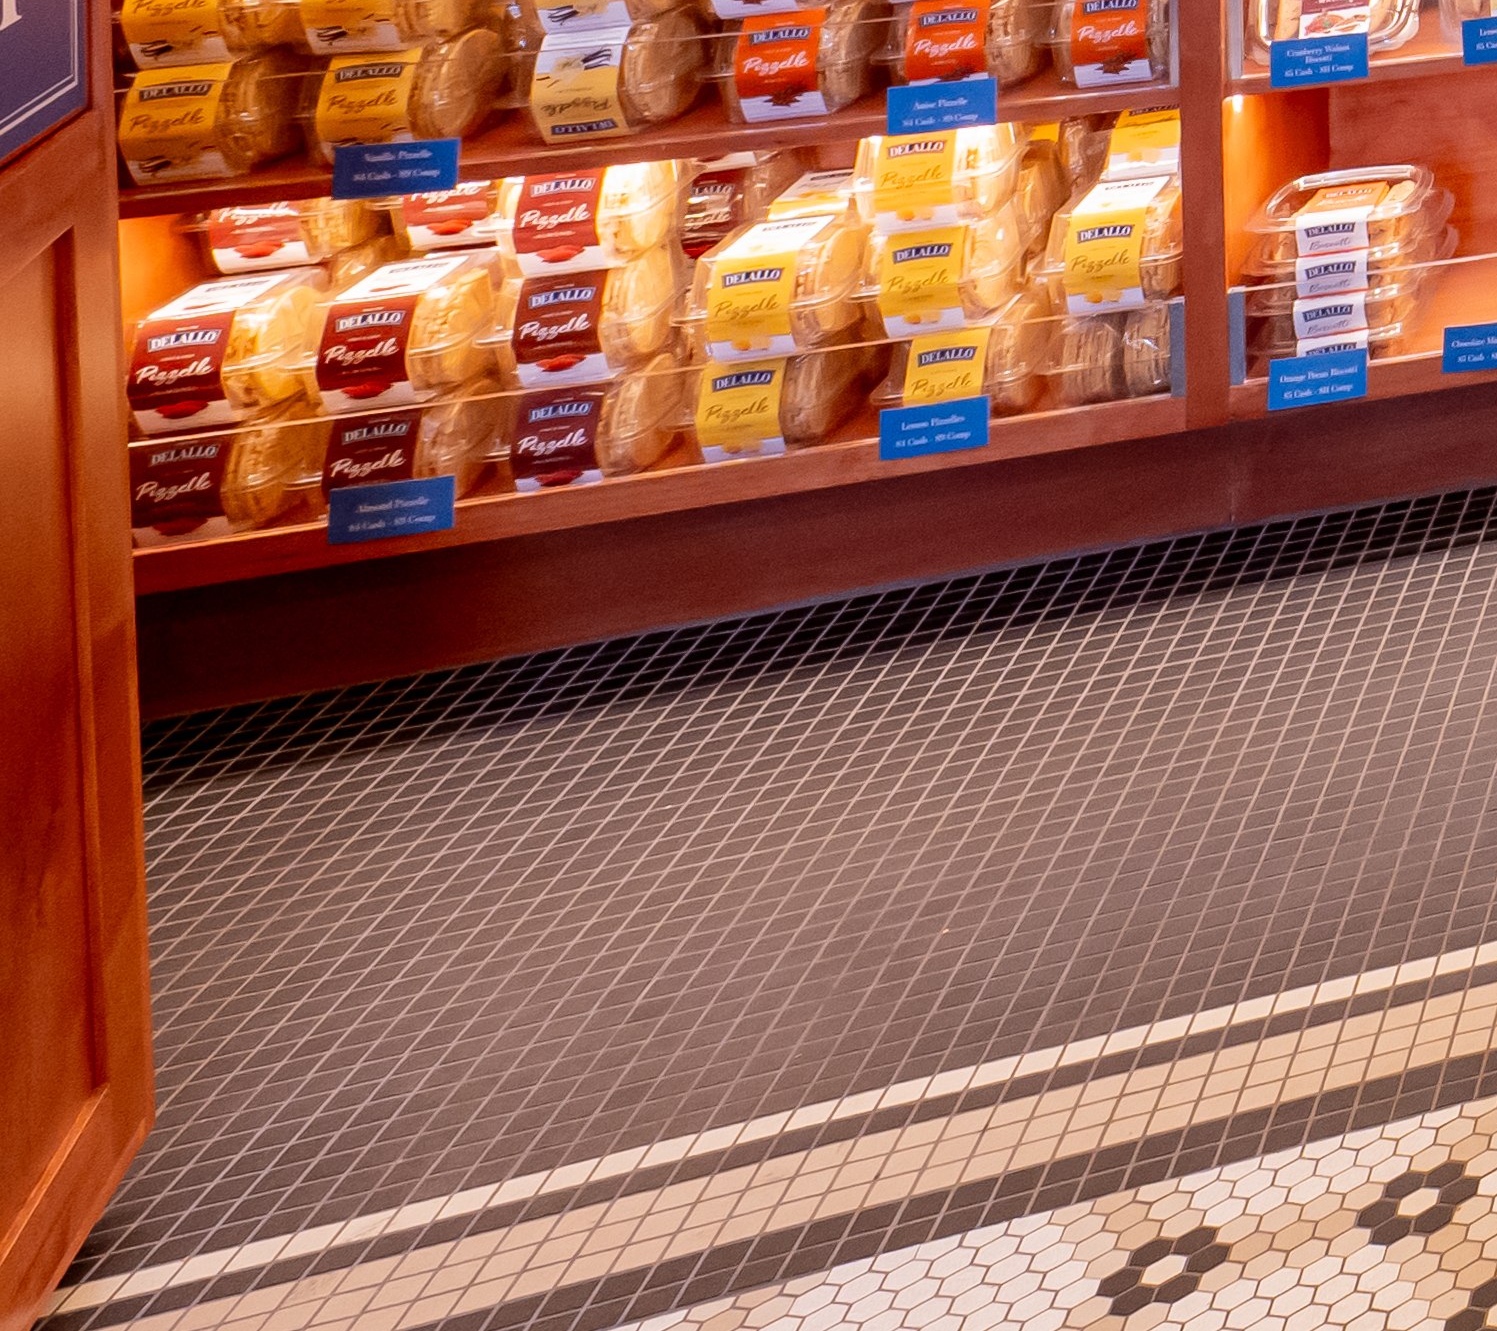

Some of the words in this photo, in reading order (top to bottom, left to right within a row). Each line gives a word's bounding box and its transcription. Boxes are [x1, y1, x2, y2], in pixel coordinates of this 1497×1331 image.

[914, 33, 978, 57] Pizzelle
[140, 80, 213, 101] DELALLO
[325, 90, 399, 114] Pizzelle
[893, 242, 951, 262] DELALLO
[1072, 249, 1130, 274] Pizzelle
[1303, 305, 1353, 322] DELALLO
[324, 339, 399, 365] Pizzelle
[529, 402, 593, 423] DELALLO
[705, 398, 770, 424] Pizzelle
[151, 444, 218, 466] DELALLO
